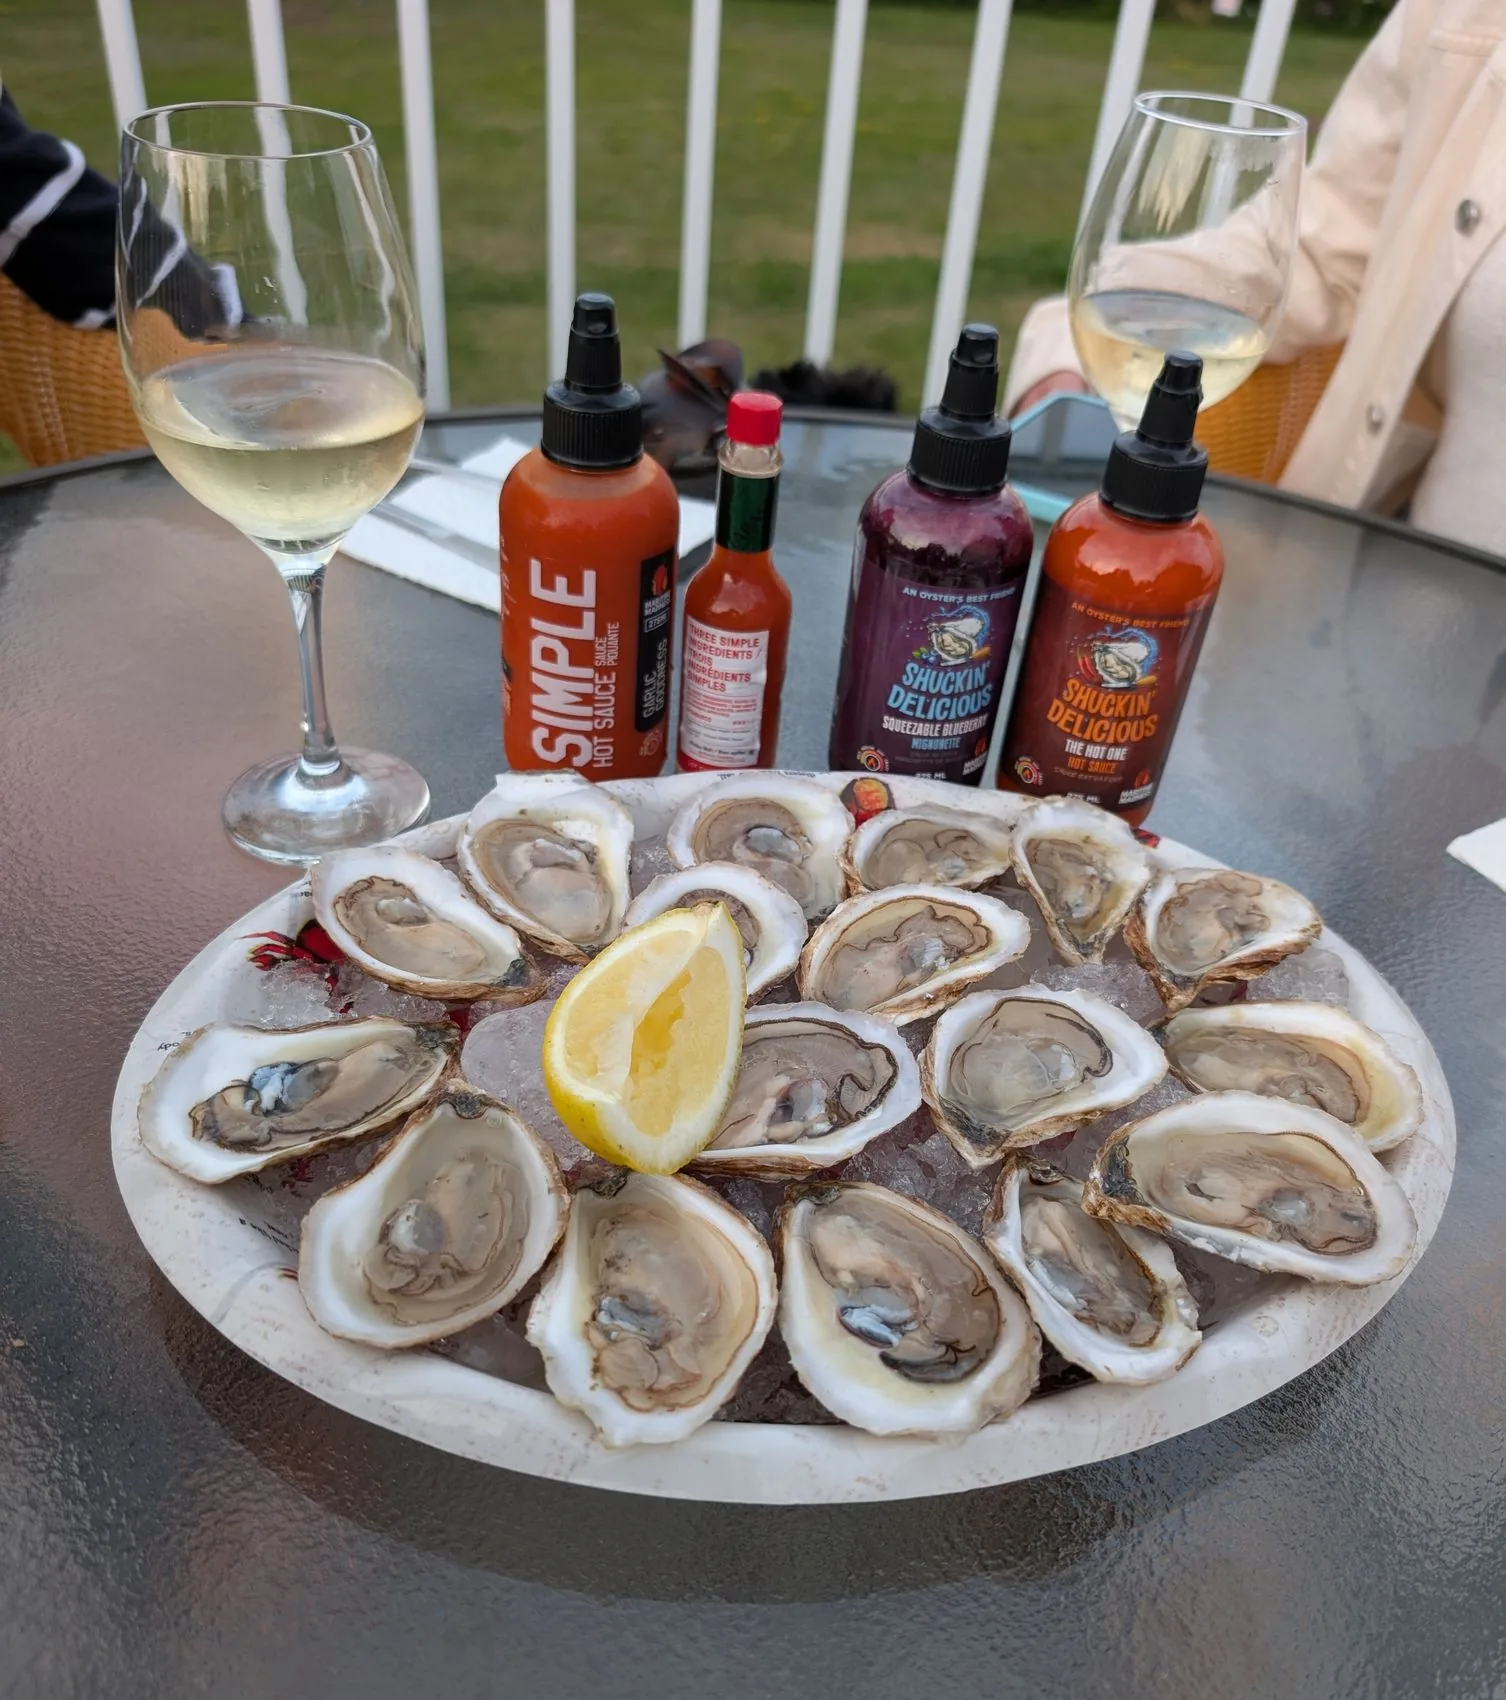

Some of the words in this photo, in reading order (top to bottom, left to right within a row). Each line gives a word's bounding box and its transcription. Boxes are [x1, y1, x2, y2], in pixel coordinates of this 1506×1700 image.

[902, 587, 917, 597] AN
[919, 591, 964, 603] OYSTER'S
[966, 593, 988, 603] BEST
[1071, 602, 1084, 613] AN
[1086, 608, 1130, 626] OYSTER'S
[1132, 619, 1157, 629] BEST
[607, 621, 620, 667] PIQUANTE
[688, 635, 753, 660] INGREDIENTS
[690, 623, 717, 645] THREE
[719, 636, 760, 649] SIMPLE
[530, 558, 596, 768] SIMPLE
[595, 636, 607, 667] SAUCE
[687, 647, 713, 667] TROIS
[687, 659, 752, 682] INGRÉDIENTS
[687, 670, 726, 693] SIMPLES
[902, 661, 991, 695] SHUCKIN'
[593, 671, 617, 730] SAUCE
[643, 669, 657, 719] GARLIC
[887, 684, 993, 720] DELICIOUS
[1062, 678, 1156, 717] SHUCKIN'
[882, 715, 941, 737] SQUEEZABLE
[942, 713, 989, 736] BLUEBERRY
[1046, 698, 1159, 743] DELICIOUS
[592, 734, 614, 768] HOT
[1064, 739, 1085, 756] THE
[1084, 743, 1107, 759] HOT
[1106, 746, 1129, 761] ONE
[1067, 756, 1085, 769] HOT
[1087, 761, 1119, 774] SAUCE
